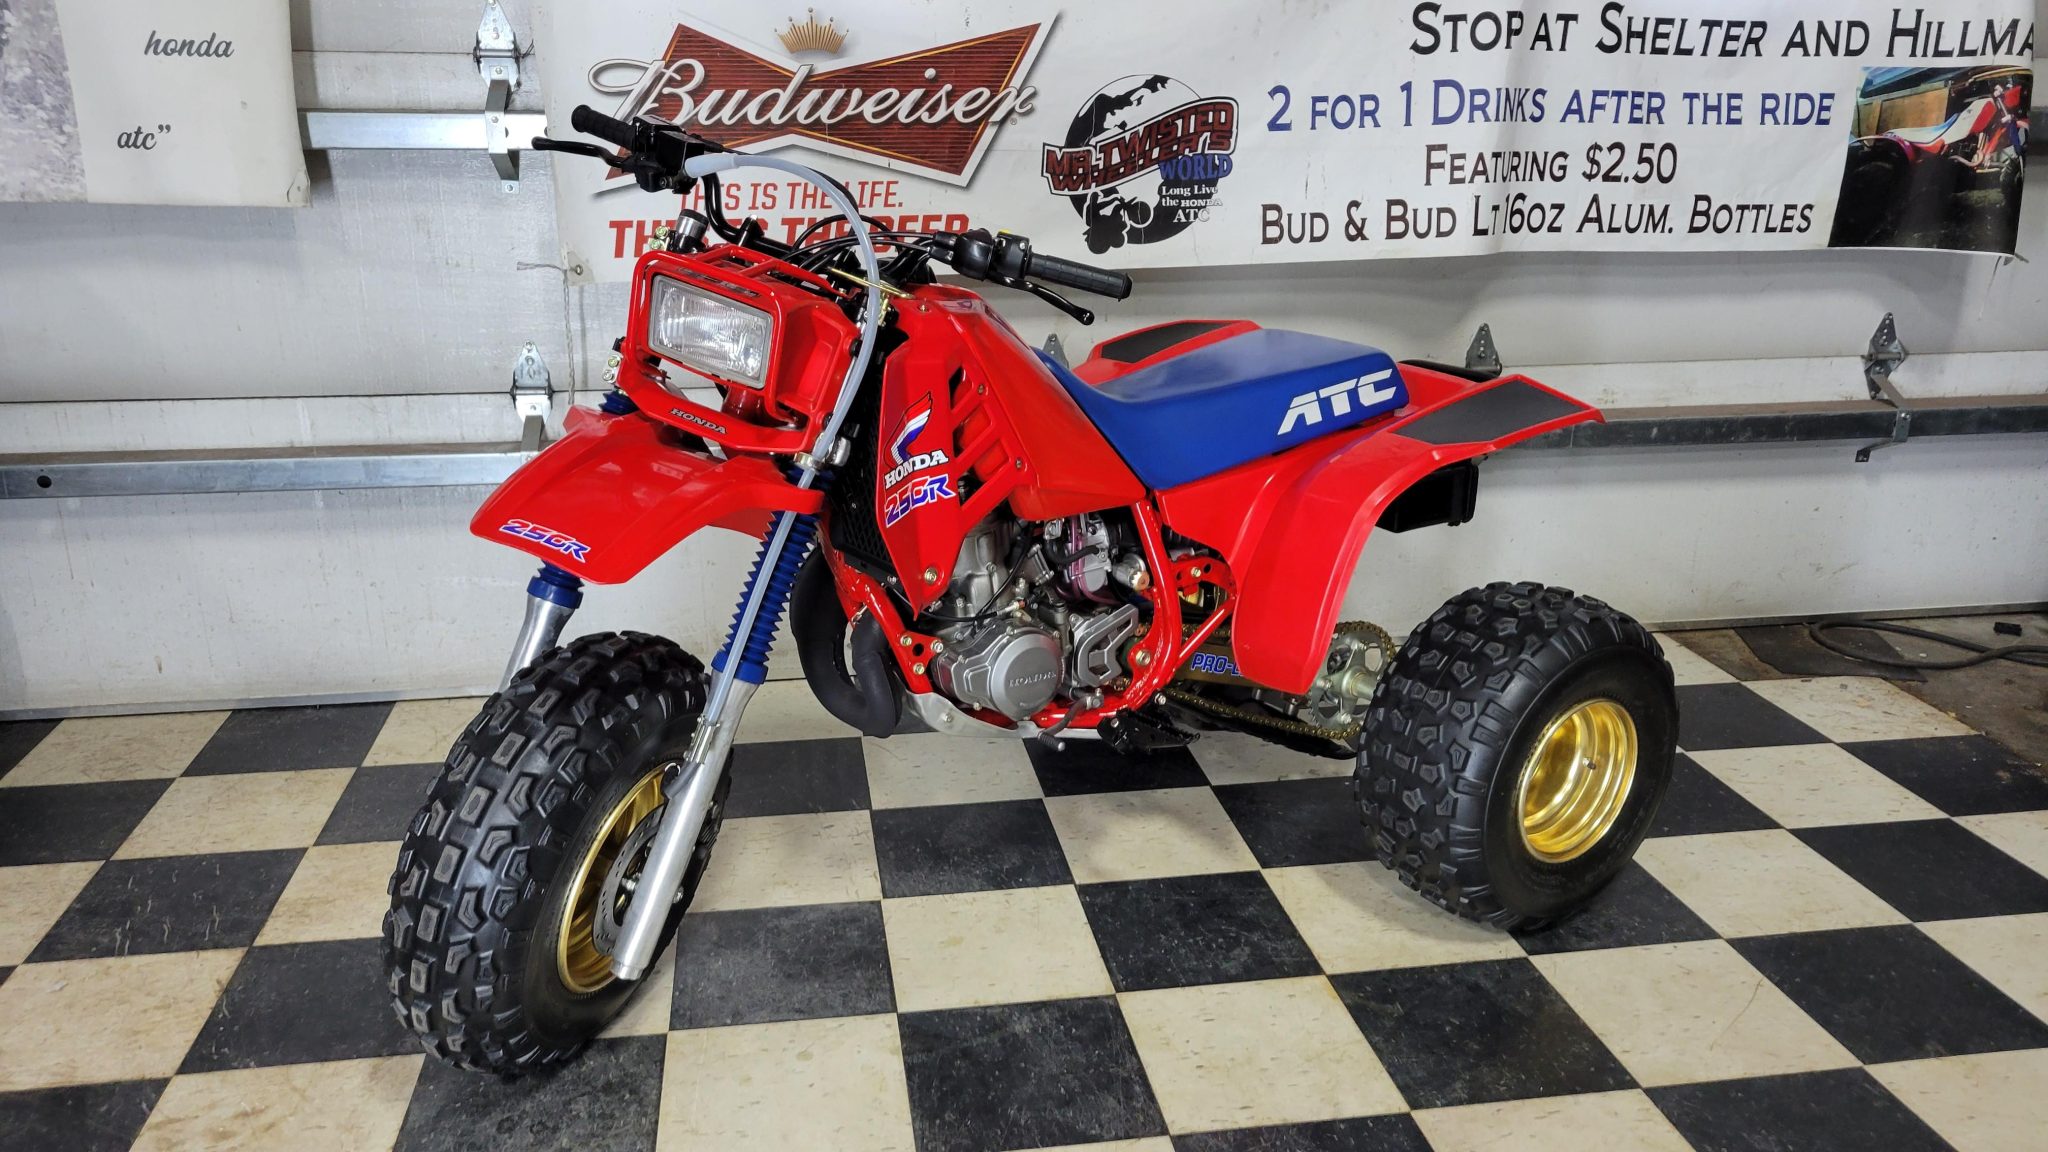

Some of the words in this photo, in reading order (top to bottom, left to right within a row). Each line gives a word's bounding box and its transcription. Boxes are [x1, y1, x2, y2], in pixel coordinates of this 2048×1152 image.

[144, 30, 235, 59] honda
[1409, 1, 1524, 56] STOP
[1529, 12, 1579, 53] AT
[1595, 1, 1768, 58] SHELTER
[1781, 19, 1870, 58] AND
[588, 57, 1037, 128] Budweiser
[1266, 84, 1293, 132] 2
[1309, 93, 1382, 131] FOR
[1399, 80, 1413, 127] 1
[1431, 78, 1549, 126] DRINKS
[1560, 89, 1666, 126] AFTER
[1682, 91, 1744, 126] THE
[1759, 91, 1836, 126] RIDE
[1158, 152, 1234, 181] WORLD
[1424, 143, 1570, 187] FEATURING
[1581, 141, 1678, 185] $2.50
[680, 182, 742, 211] THS
[747, 182, 779, 211] IS
[844, 180, 904, 209] IFE.
[1161, 185, 1192, 197] Long
[1193, 184, 1219, 195] Live
[1161, 196, 1180, 207] the
[1180, 198, 1224, 208] HONDA
[1172, 207, 1211, 223] ATC
[1260, 202, 1330, 245] BUD
[1344, 199, 1370, 242] &
[1384, 198, 1458, 241] BUD
[1576, 192, 1674, 234] ALUM.
[1686, 193, 1815, 235] BOTTLES
[669, 407, 728, 435] HONDA
[1277, 368, 1397, 436] ATC
[884, 448, 950, 491] HONDA
[884, 473, 957, 529] 250R
[499, 518, 592, 564] 250R
